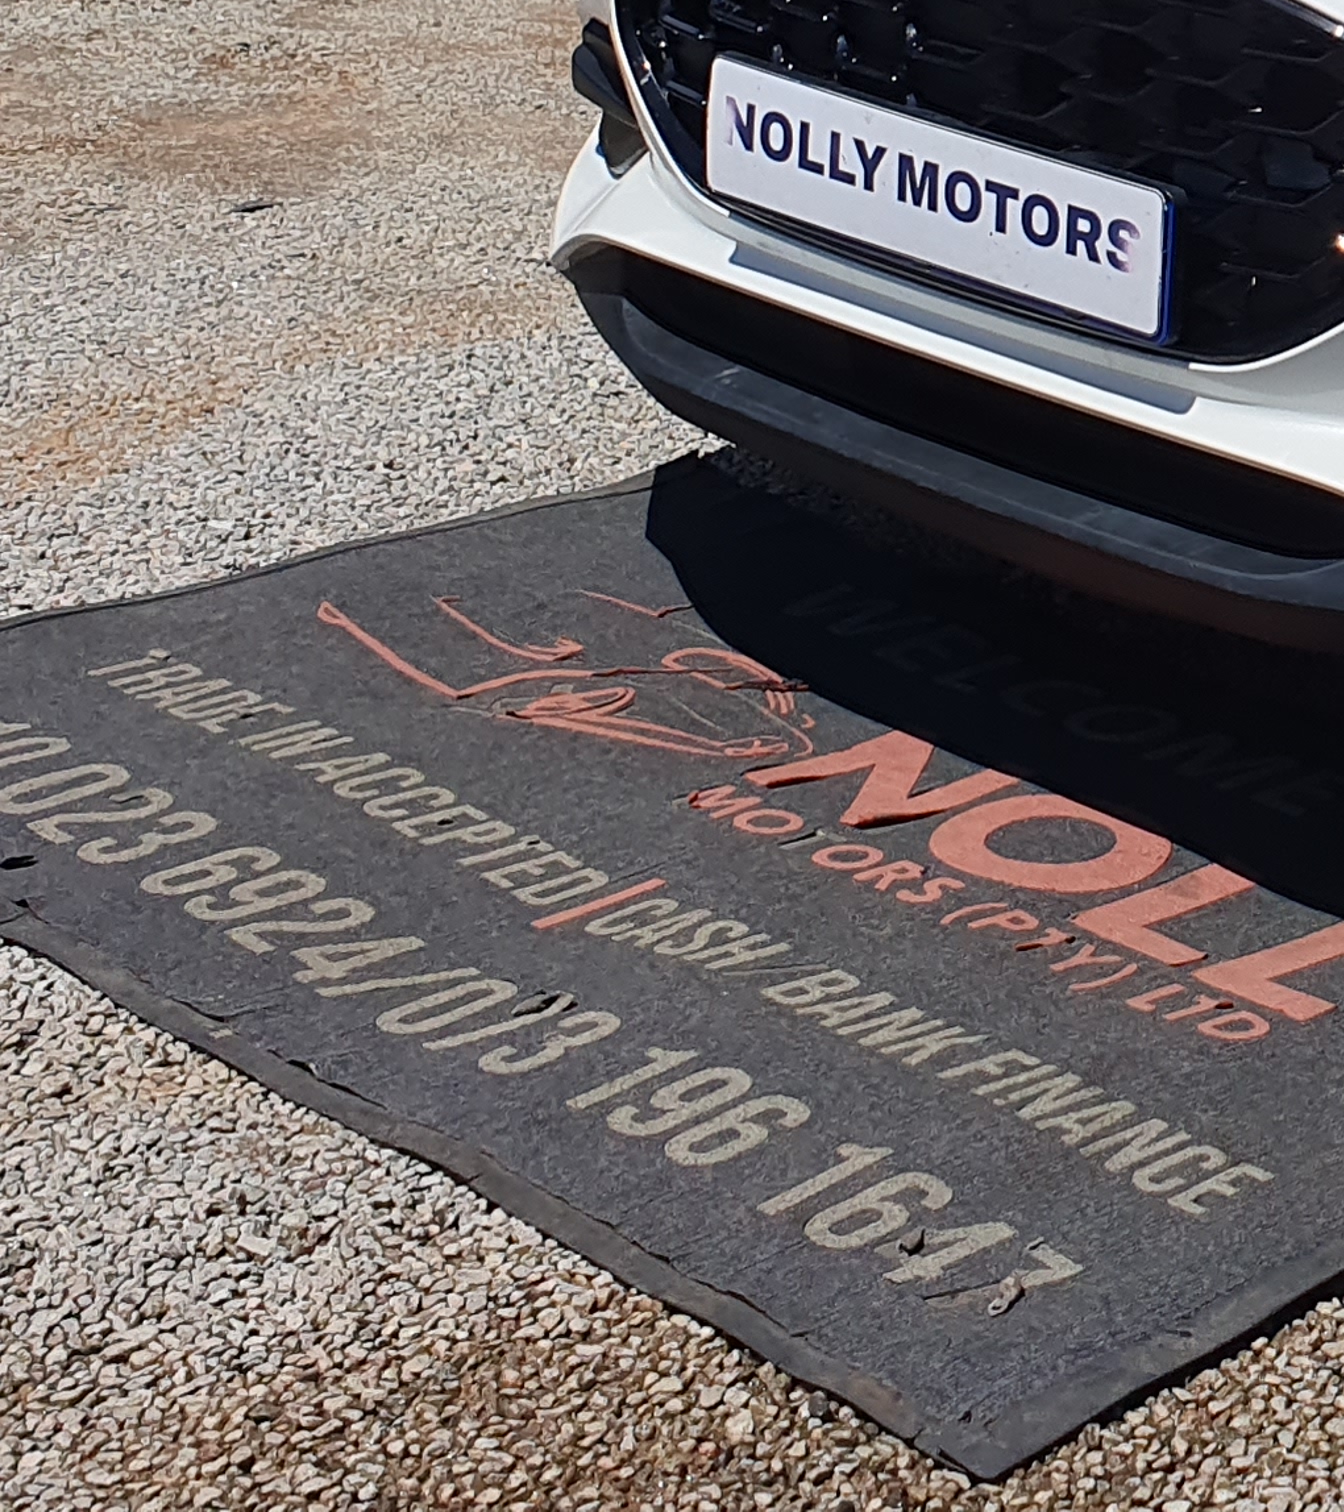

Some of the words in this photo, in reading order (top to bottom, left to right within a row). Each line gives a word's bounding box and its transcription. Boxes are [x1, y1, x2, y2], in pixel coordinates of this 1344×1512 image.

[725, 95, 888, 192] NOLLY
[897, 152, 1142, 274] MOTORS
[87, 648, 296, 734] TRADE
[937, 1048, 1275, 1218] FINANCE
[684, 784, 966, 904] MOTORS
[940, 902, 1138, 992] (PTY)
[1125, 982, 1272, 1042] LTD
[566, 1046, 812, 1167] 196
[756, 1142, 1086, 1318] 1647
